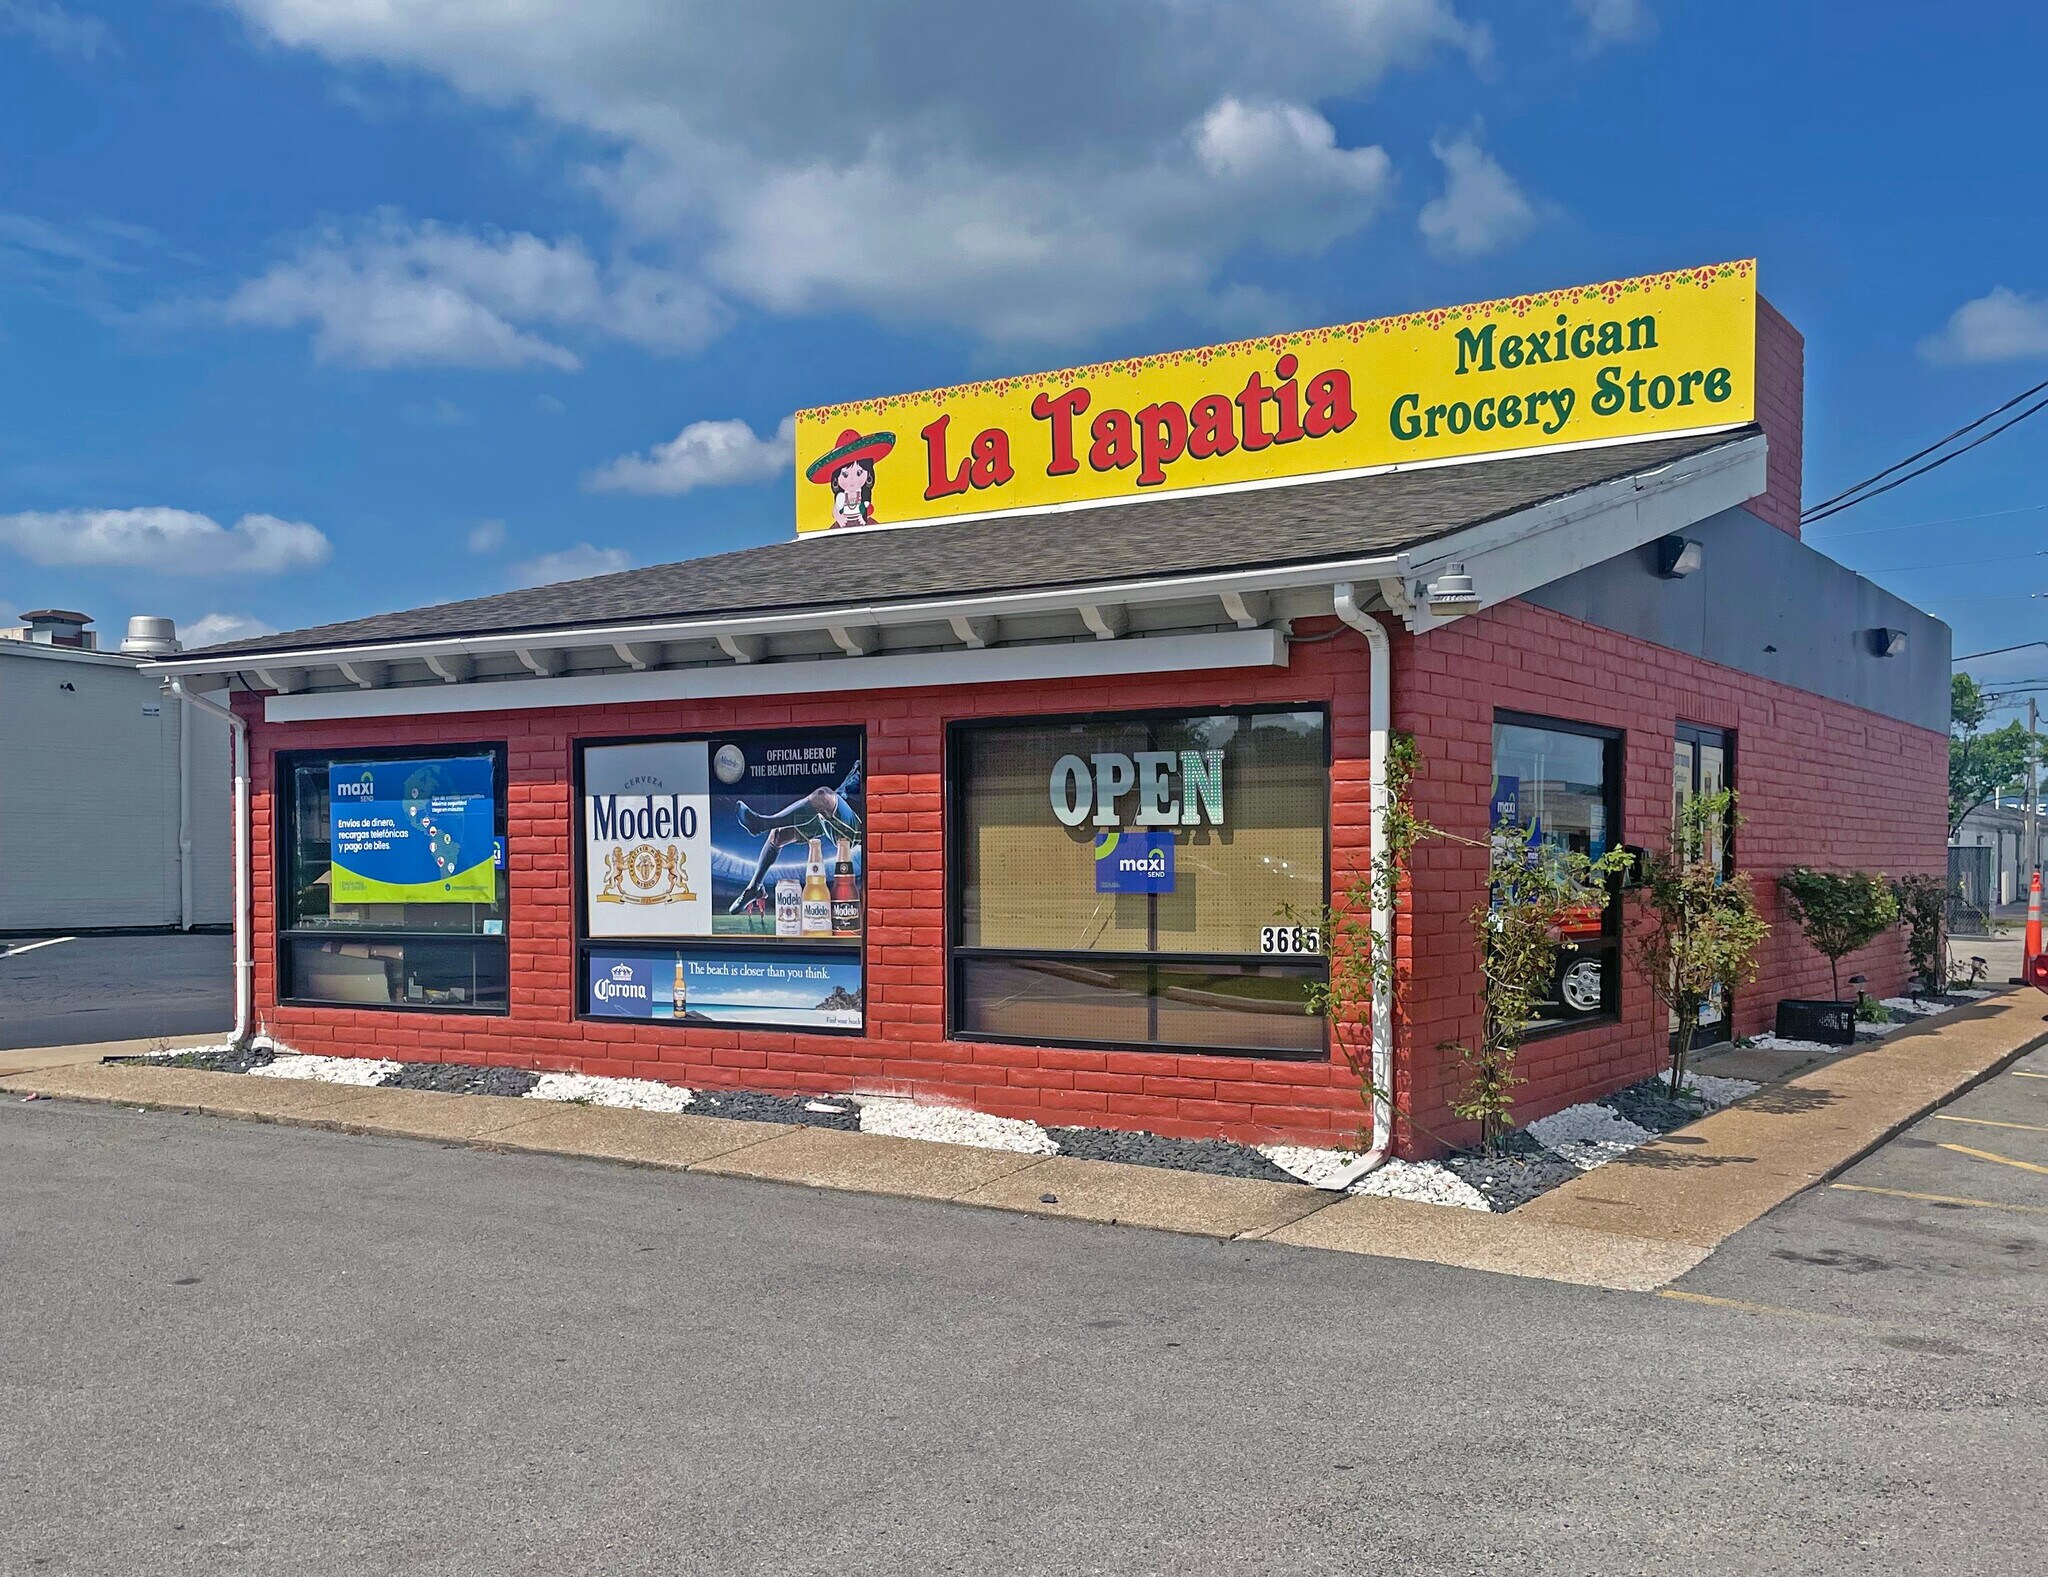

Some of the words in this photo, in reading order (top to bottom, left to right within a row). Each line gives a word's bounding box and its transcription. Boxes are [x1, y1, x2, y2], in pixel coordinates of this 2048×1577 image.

[1454, 313, 1658, 376] Mexican
[1389, 387, 1576, 435] Grocery
[1591, 366, 1732, 417] Store
[921, 413, 1015, 501] La
[1032, 353, 1357, 487] Tapatia
[766, 749, 803, 762] OFFICIAL
[803, 748, 825, 760] BEER
[825, 747, 837, 759] OF
[750, 765, 766, 777] THE
[767, 763, 810, 776] BEAUTIFUL
[811, 762, 835, 775] GAME
[337, 779, 374, 796] maxi
[624, 775, 663, 790] CERVEZA
[1049, 749, 1225, 827] OPEN
[338, 818, 360, 828] Envíos
[361, 818, 370, 828] de
[371, 818, 395, 828] dinero,
[592, 793, 698, 841] Modelo
[338, 831, 369, 841] recargas
[370, 829, 409, 838] telefónicas
[338, 843, 344, 853] y
[344, 842, 362, 853] pago
[363, 841, 372, 850] de
[1119, 855, 1165, 871] maxi
[777, 892, 802, 906] Modelo
[805, 904, 828, 916] Modelo
[833, 905, 857, 917] Modelo
[1263, 927, 1318, 952] 3685
[688, 962, 705, 975] The
[707, 963, 729, 975] beach
[731, 965, 738, 976] is
[740, 965, 765, 976] closer
[767, 965, 785, 977] than
[787, 969, 803, 982] you
[805, 966, 830, 979] think.
[594, 978, 647, 1003] Corona
